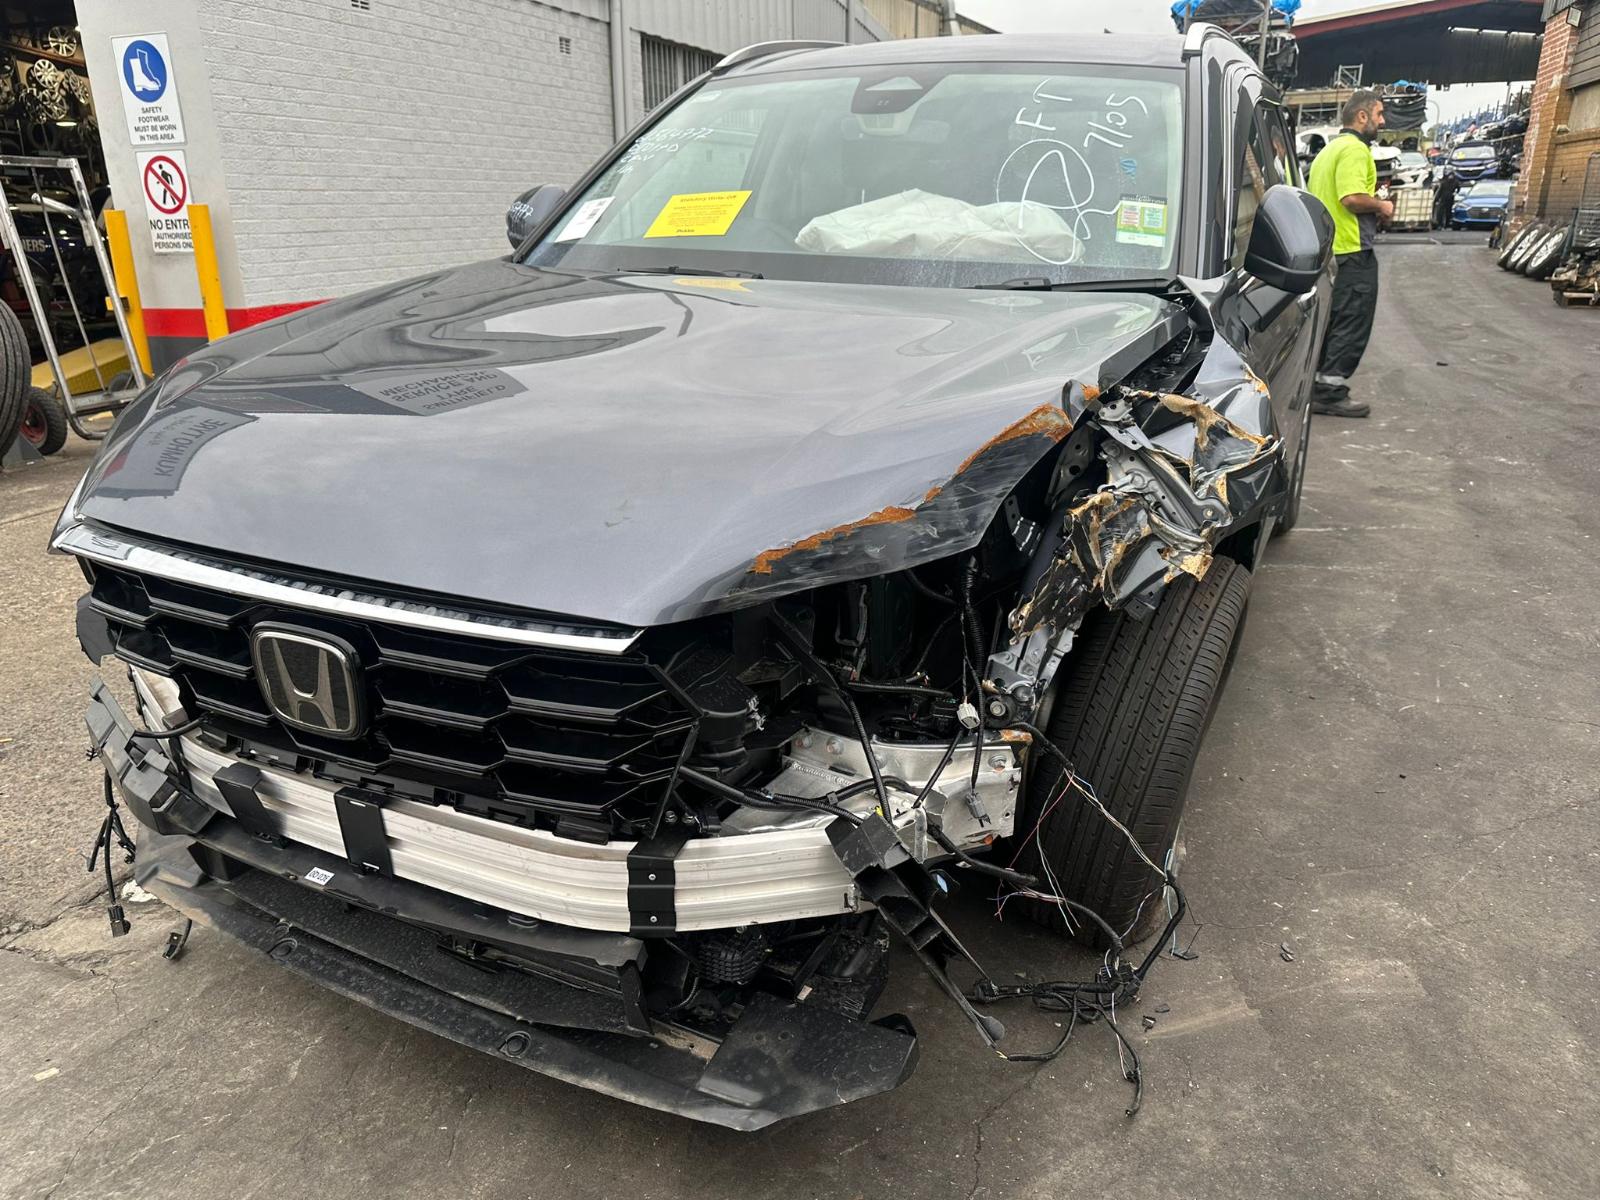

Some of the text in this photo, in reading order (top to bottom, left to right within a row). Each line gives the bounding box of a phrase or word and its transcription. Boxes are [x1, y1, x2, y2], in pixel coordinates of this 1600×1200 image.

[141, 106, 162, 114] SAFETY
[138, 115, 170, 123] FOOTWEAR
[149, 218, 190, 230] NO ENTR
[154, 241, 195, 249] PERSONS ONL
